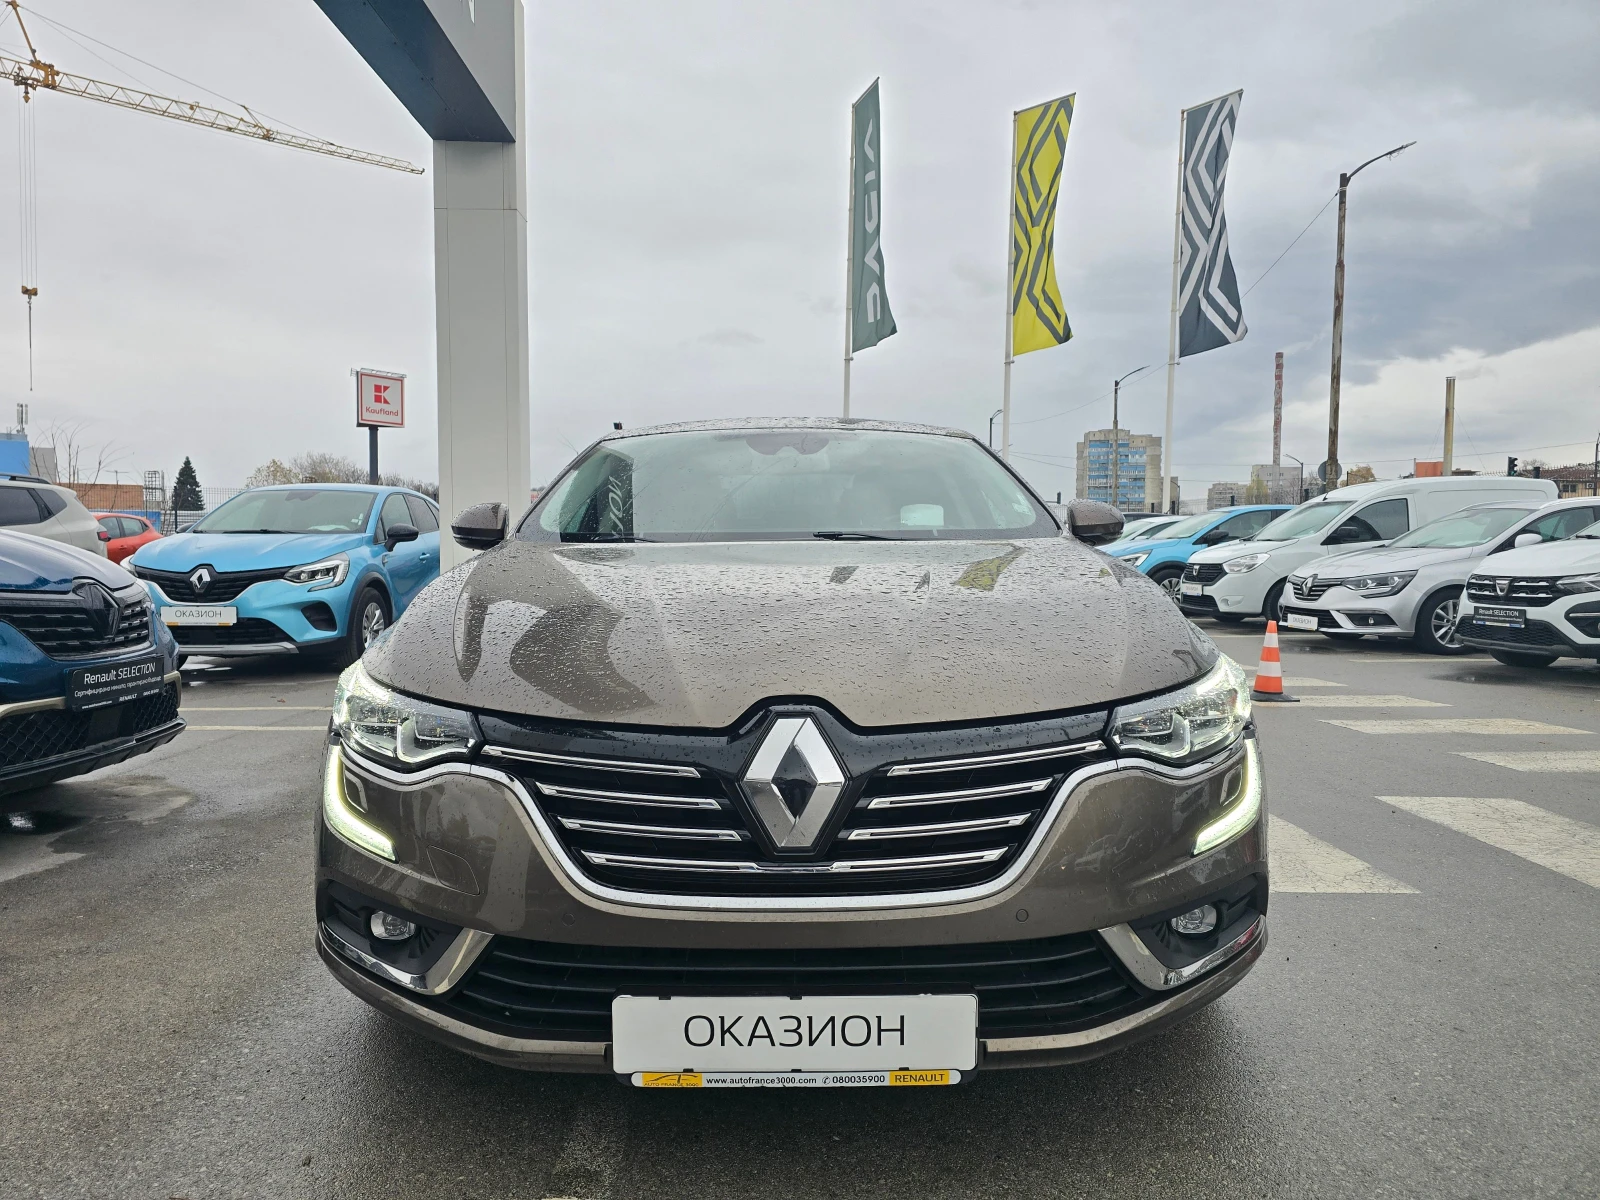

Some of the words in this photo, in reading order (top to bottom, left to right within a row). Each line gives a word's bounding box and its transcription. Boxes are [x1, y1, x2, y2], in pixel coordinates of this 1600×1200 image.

[864, 118, 881, 323] DACIA
[366, 406, 399, 417] Kaufland
[174, 609, 222, 618] ОКАЗИОН
[84, 669, 116, 684] Renault
[117, 662, 156, 680] SELECTION
[684, 1015, 906, 1047] ОКАЗИОН
[705, 1076, 817, 1085] www.autofrance3000.com
[832, 1074, 886, 1084] 080035900
[894, 1073, 946, 1083] RENAULT
